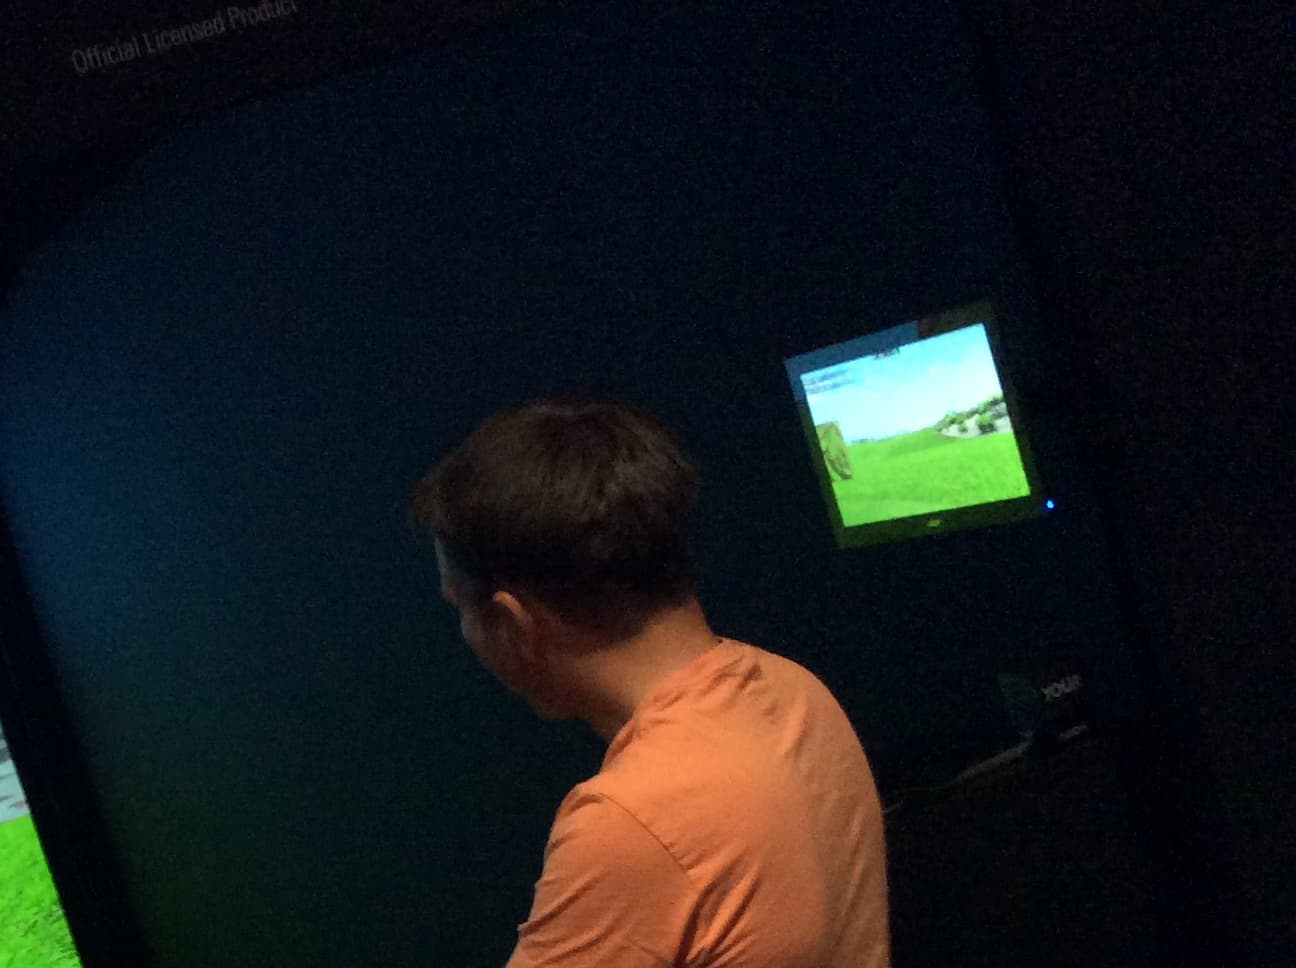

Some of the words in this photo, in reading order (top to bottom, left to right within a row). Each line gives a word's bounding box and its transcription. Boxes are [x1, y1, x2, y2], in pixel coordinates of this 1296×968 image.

[71, 37, 140, 74] Official
[142, 14, 226, 57] Licensed
[227, 0, 299, 30] Product
